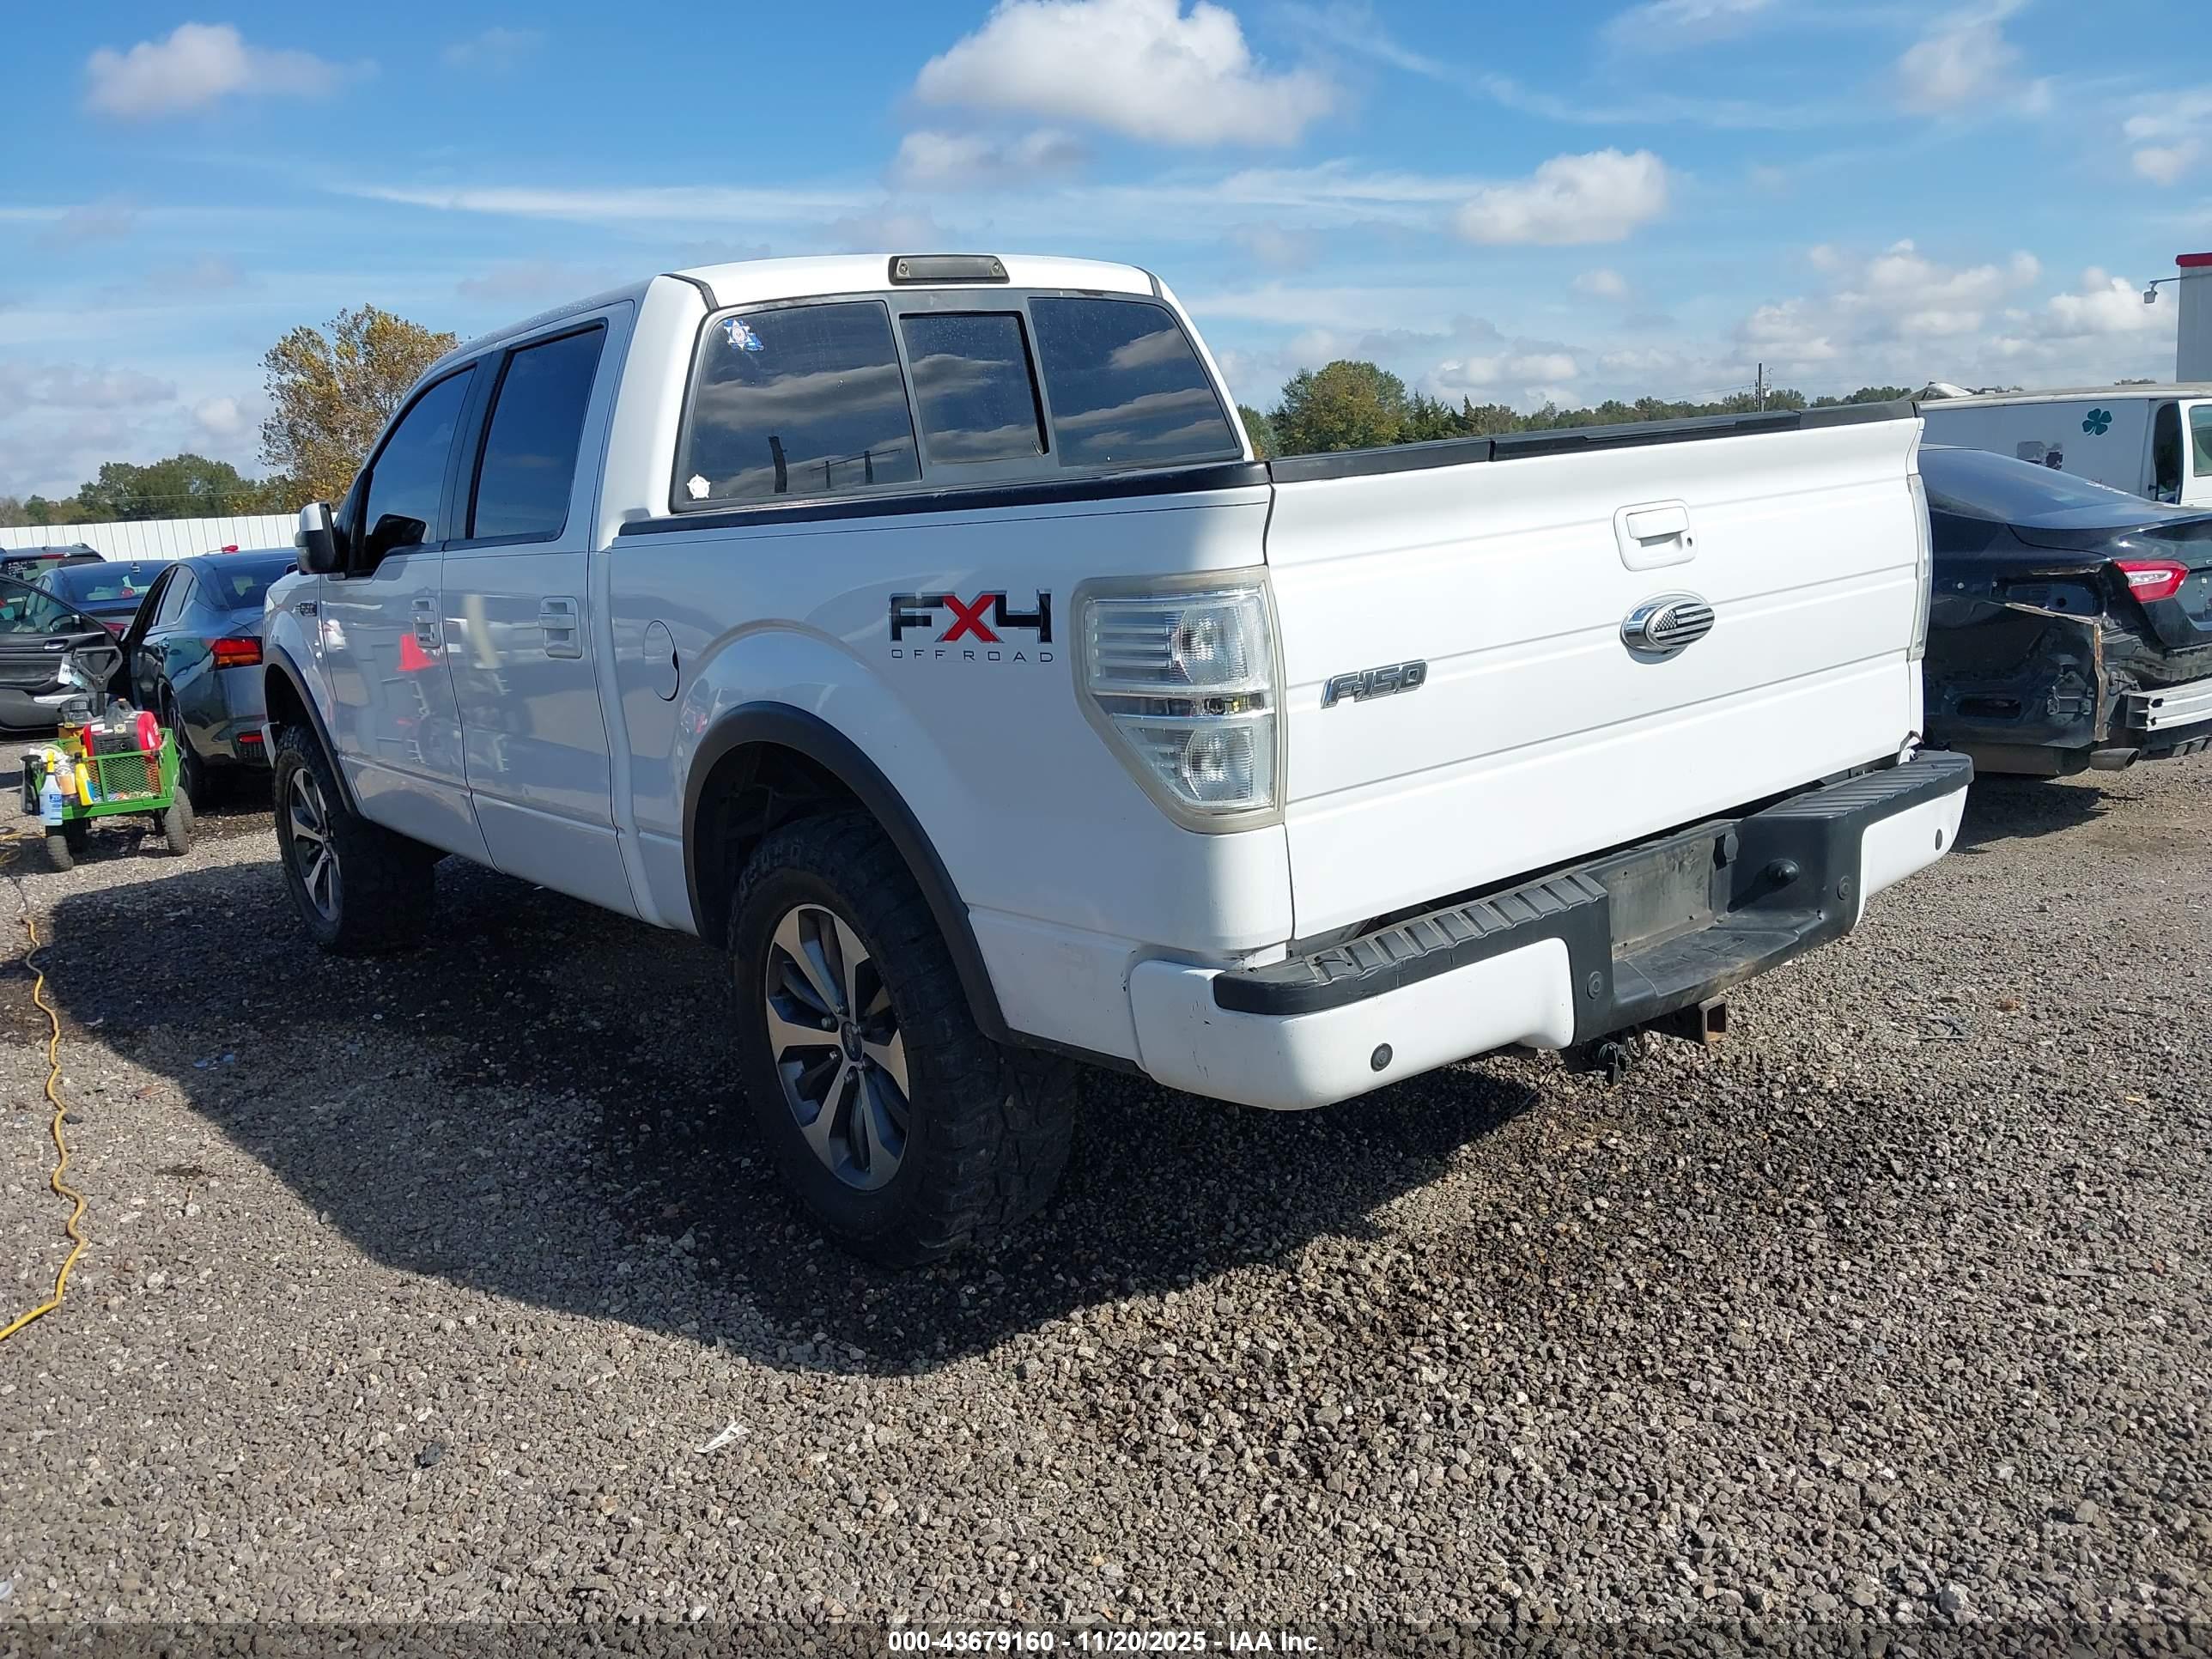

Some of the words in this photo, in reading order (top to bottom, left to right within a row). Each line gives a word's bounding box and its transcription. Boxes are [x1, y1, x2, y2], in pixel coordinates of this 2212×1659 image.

[889, 589, 1053, 644] FX4
[890, 648, 946, 661] OFF
[963, 649, 1054, 663] ROAD
[1320, 659, 1429, 709] F-150
